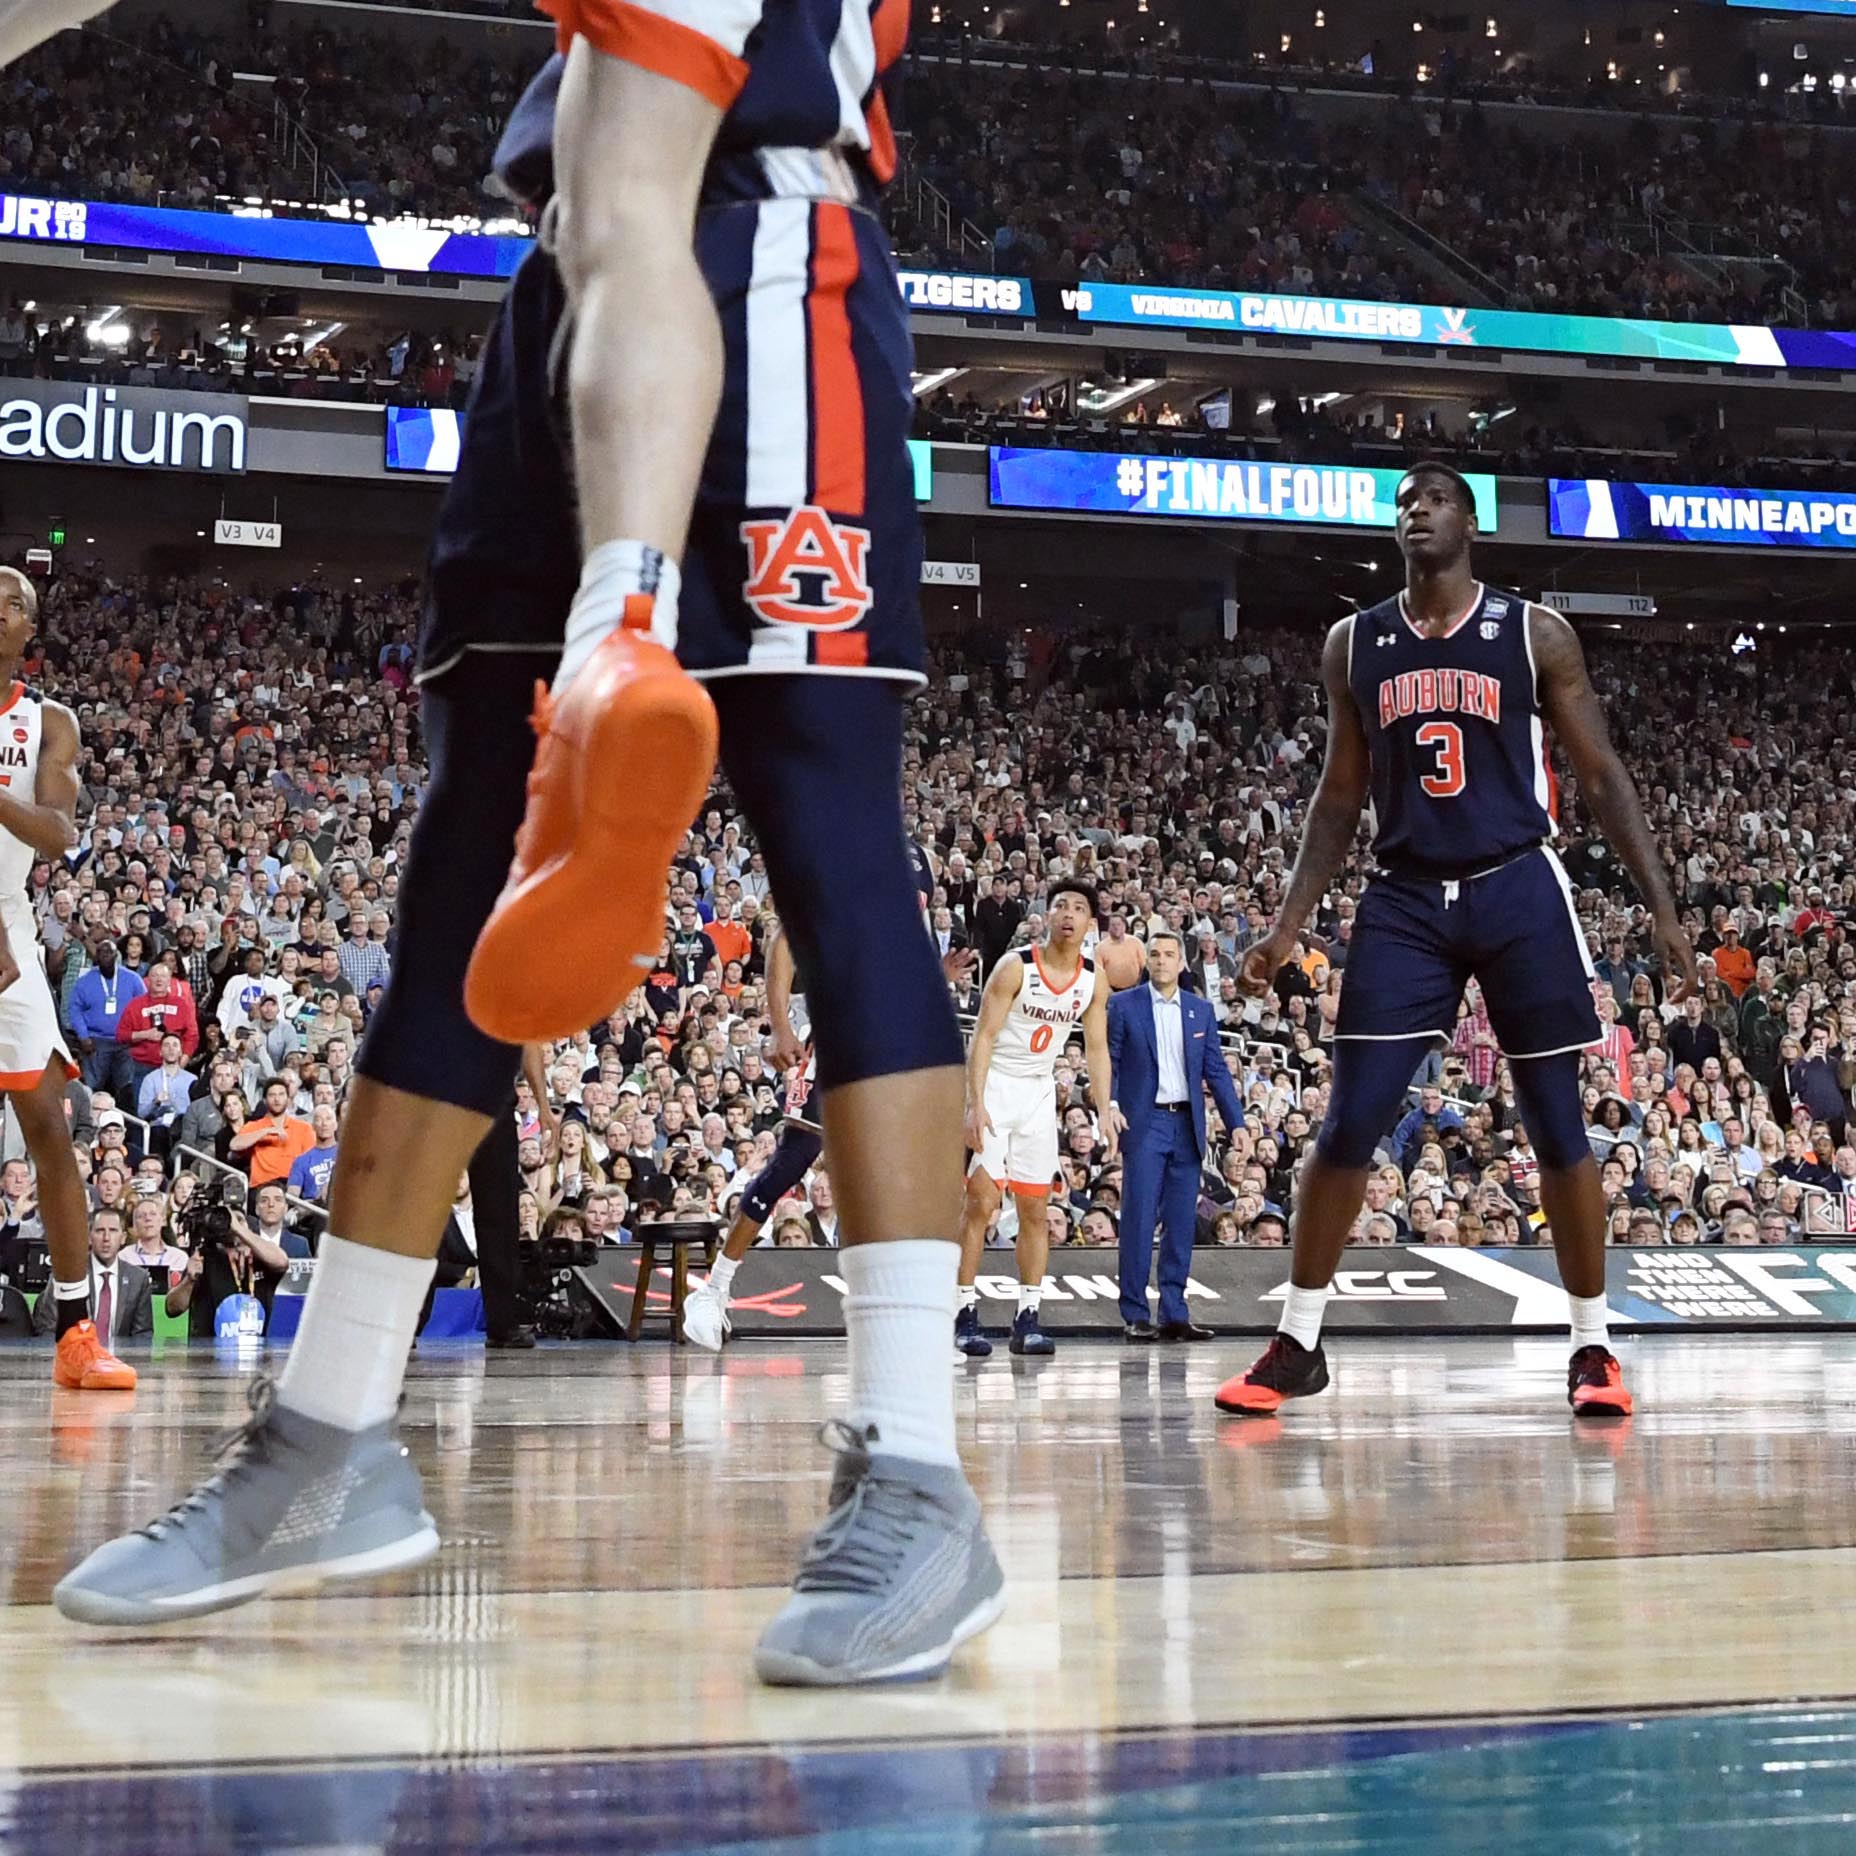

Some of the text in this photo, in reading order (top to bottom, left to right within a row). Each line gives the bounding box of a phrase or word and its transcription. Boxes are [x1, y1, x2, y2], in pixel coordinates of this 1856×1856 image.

[1060, 289, 1093, 311] VS
[1131, 294, 1234, 321] VIRGINIA
[1240, 297, 1422, 337] CAVALIERS
[1116, 458, 1376, 521] #FINALFOUR
[221, 523, 276, 542] V3 V4
[923, 564, 975, 581] V4 V5
[1551, 595, 1648, 612] 111 112
[1378, 667, 1501, 730] AUBURN
[1415, 721, 1467, 798] 3
[1021, 1003, 1079, 1023] VIRGINIA
[1029, 1024, 1054, 1054] 0
[1632, 1253, 1713, 1268] AND
[1626, 1269, 1735, 1284] THEN
[1626, 1285, 1757, 1301] THERE
[1662, 1301, 1779, 1317] WERE
